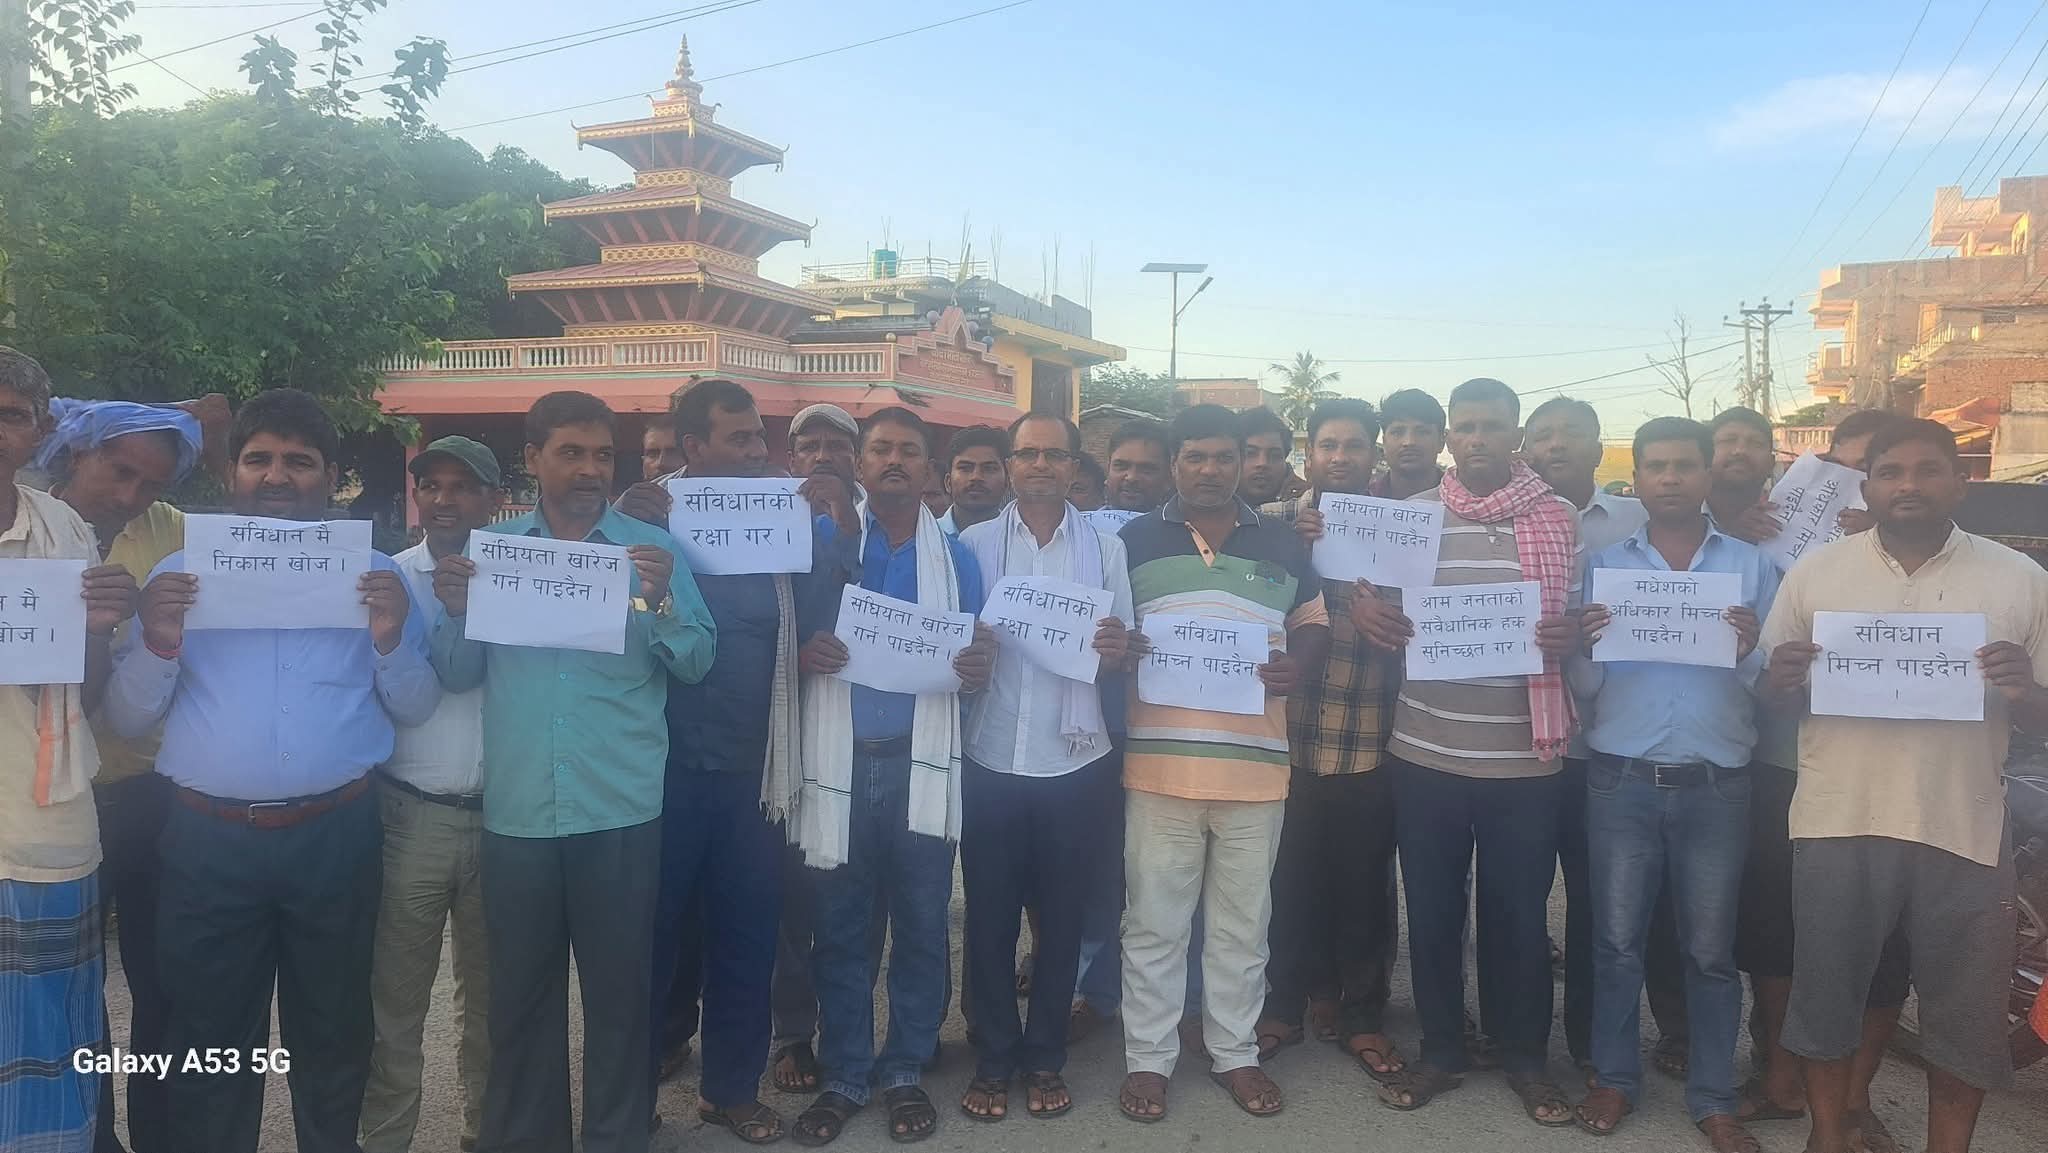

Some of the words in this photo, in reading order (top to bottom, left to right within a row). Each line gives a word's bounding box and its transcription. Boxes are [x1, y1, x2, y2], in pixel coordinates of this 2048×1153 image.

[684, 487, 795, 512] संविधानको
[1331, 498, 1385, 519] संघियता
[1393, 506, 1432, 525] खारेज
[229, 521, 304, 544] संविधान
[691, 529, 731, 546] रक्षा
[744, 529, 773, 545] गर
[1386, 528, 1430, 548] पाइदैन
[213, 550, 278, 571] निकास
[288, 552, 330, 572] खोज
[480, 539, 556, 566] संघियता
[567, 549, 620, 572] खारेज
[532, 575, 592, 600] पाइदैन
[1421, 596, 1452, 608] आम
[1460, 588, 1525, 607] जनताको
[1634, 577, 1699, 595] मधेशको
[1003, 582, 1098, 620] संविधानको
[1611, 600, 1673, 619] अधिकार
[1681, 602, 1723, 621] मिच्न
[851, 595, 913, 626] संघियता
[921, 616, 968, 639] खारेज
[1501, 616, 1526, 631] हक
[997, 616, 1033, 640] रक्षा
[1043, 627, 1070, 649] गर
[1174, 621, 1239, 646] संविधान
[1632, 624, 1684, 644] पाइदैन
[1854, 620, 1943, 644] संविधान
[888, 635, 939, 659] पाइदैन
[1493, 642, 1516, 655] गर
[1151, 647, 1193, 670] मिच्न
[1203, 653, 1257, 677] पाइदैन
[1827, 651, 1884, 675] मिच्न
[1896, 651, 1970, 678] पाइदैन
